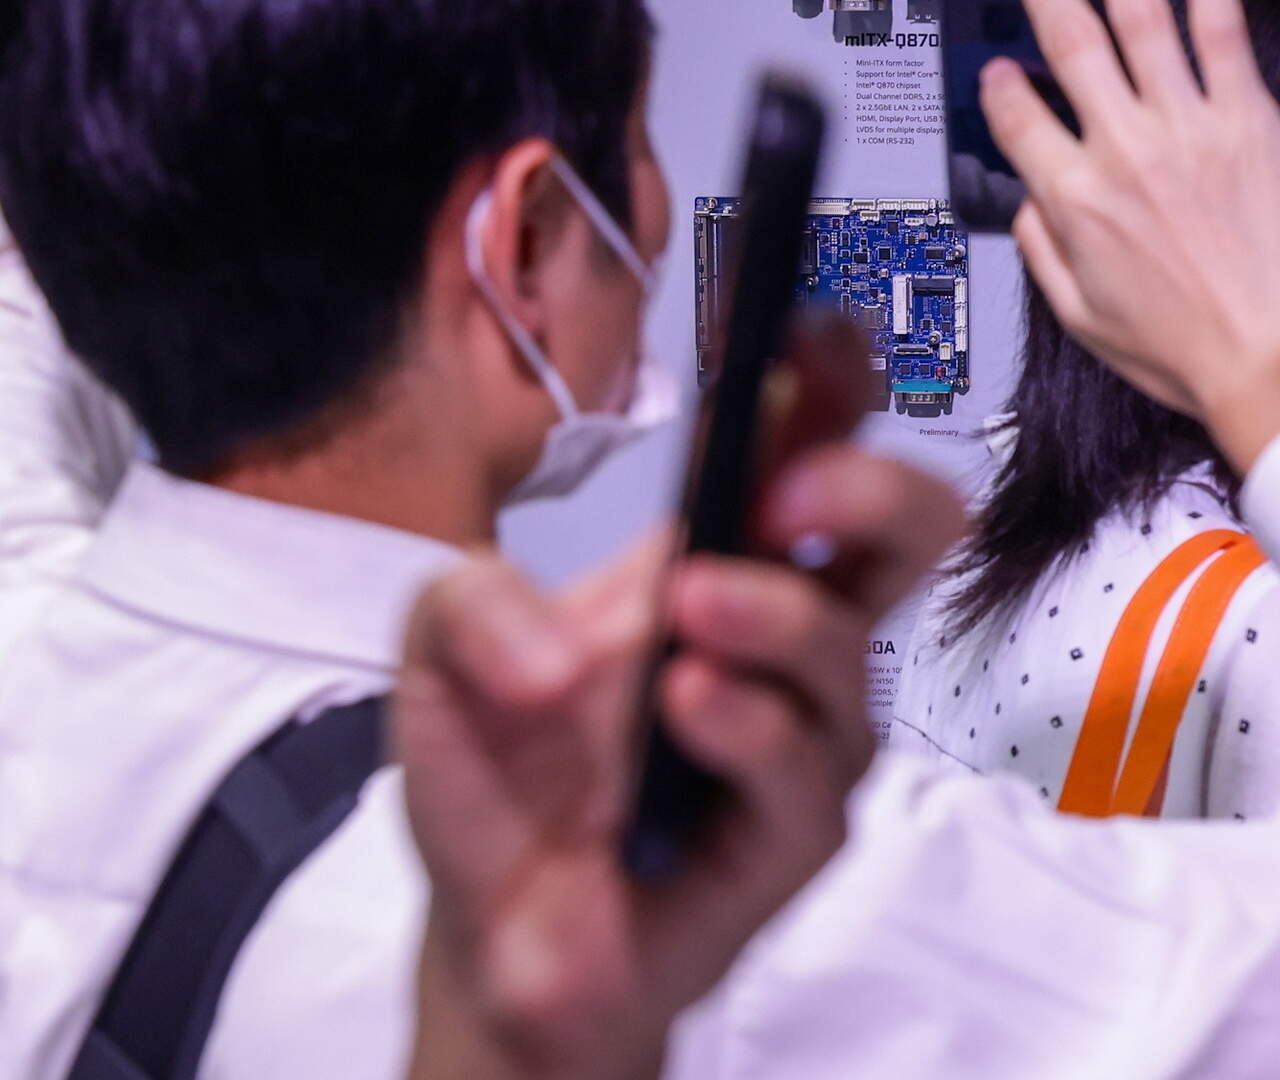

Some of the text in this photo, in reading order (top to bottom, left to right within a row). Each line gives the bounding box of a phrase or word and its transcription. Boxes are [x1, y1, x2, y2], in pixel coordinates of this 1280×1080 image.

[845, 34, 942, 49] mITX-Q870
[856, 58, 925, 67] Mini-ITX form factor
[856, 125, 943, 135] LVDS for multiple displays
[919, 429, 958, 437] Preliminary
